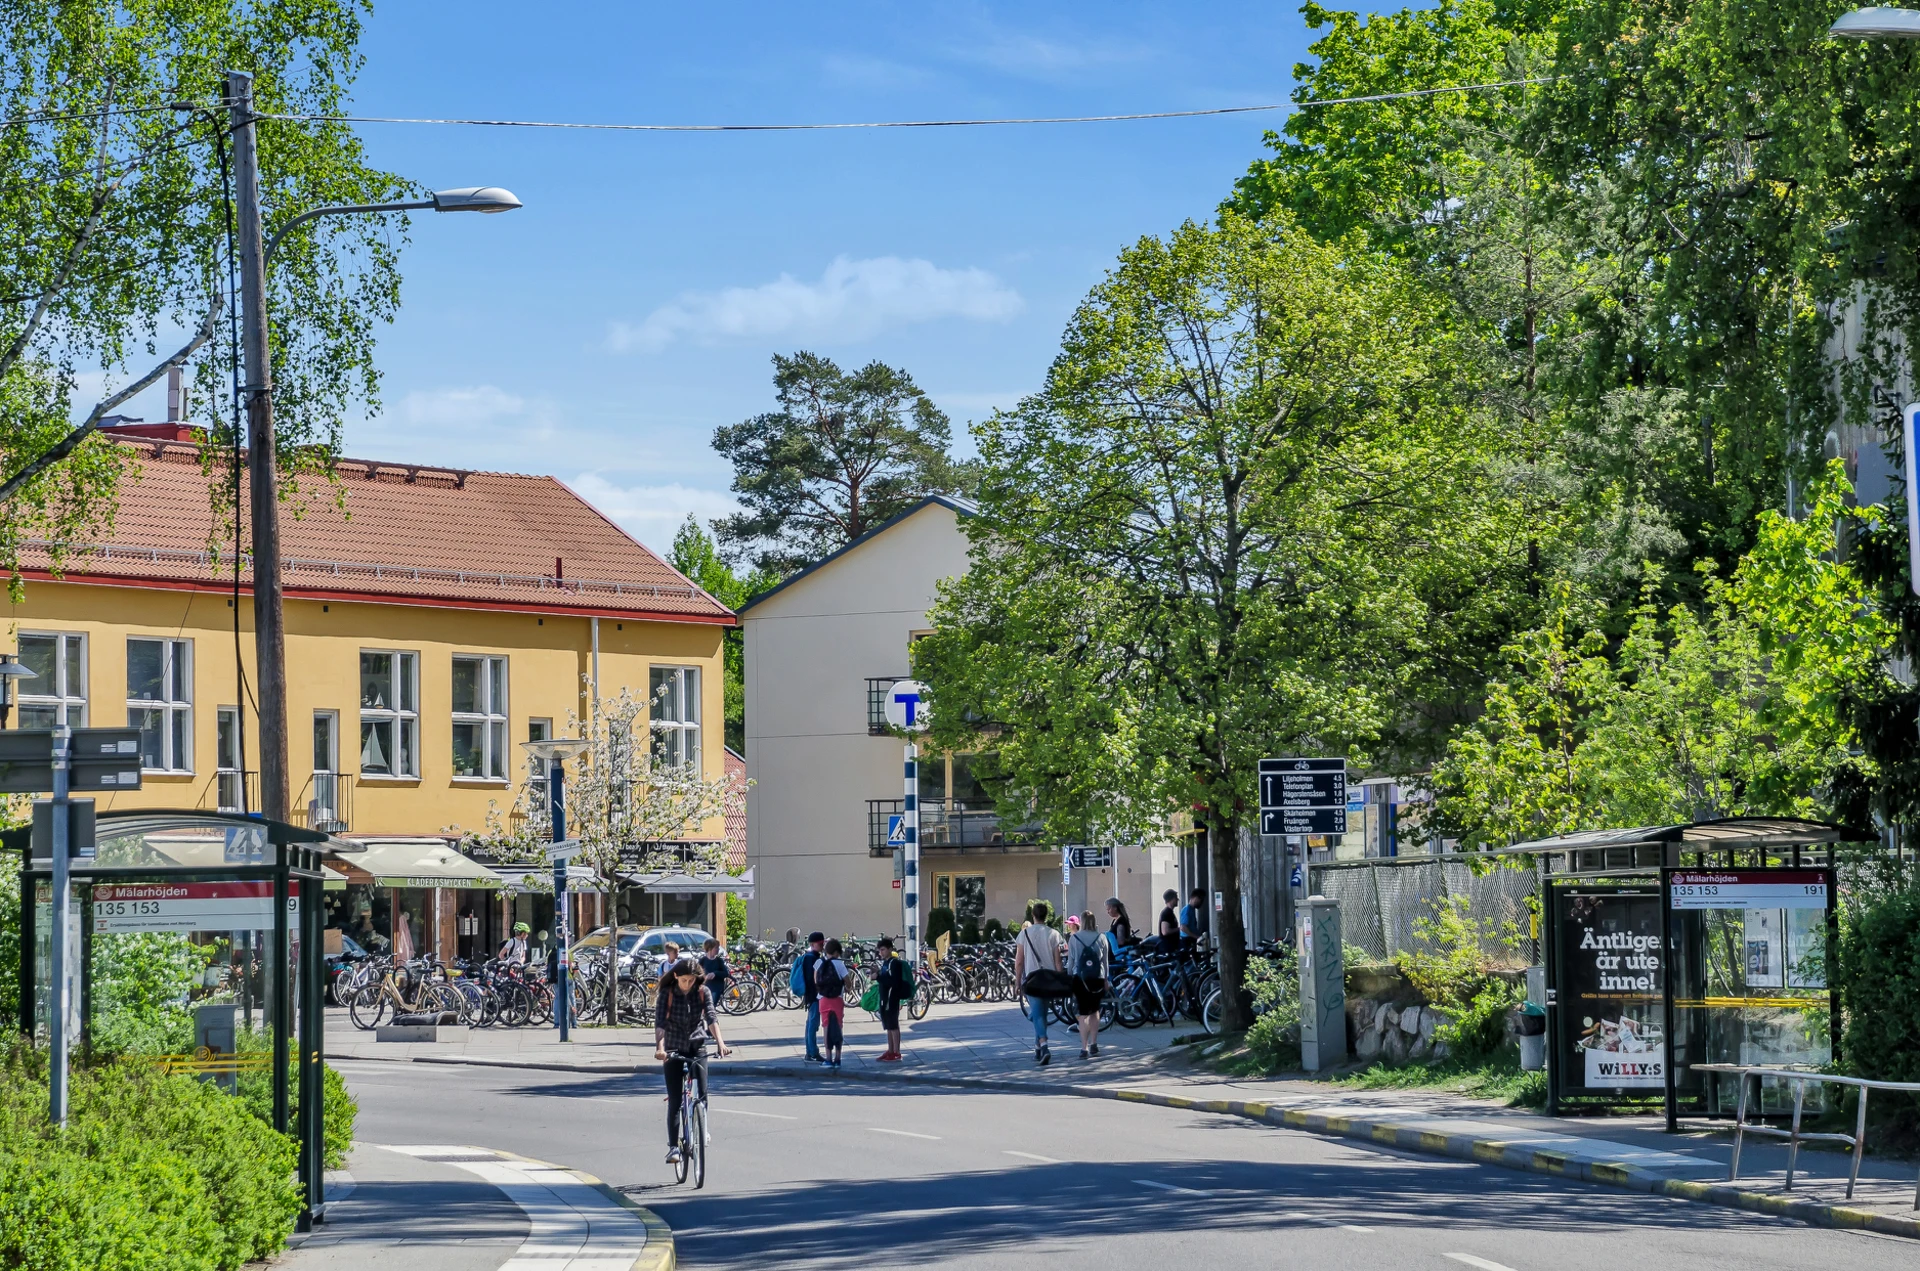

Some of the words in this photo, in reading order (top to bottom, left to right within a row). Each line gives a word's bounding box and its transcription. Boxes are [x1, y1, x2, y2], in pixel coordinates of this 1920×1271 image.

[894, 694, 921, 726] T
[1283, 798, 1311, 806] Axelsberg
[1686, 874, 1738, 884] Mälarhöjden
[115, 887, 188, 898] Mälarhöjden
[1672, 886, 1694, 896] 135
[1697, 886, 1719, 896] 153
[1803, 885, 1824, 895] 191
[96, 902, 126, 916] 135
[131, 901, 160, 914] 153
[1596, 951, 1620, 970] är
[1625, 953, 1659, 970] ute
[1599, 971, 1656, 990] inne!
[1598, 1062, 1662, 1076] WiLLY:S
